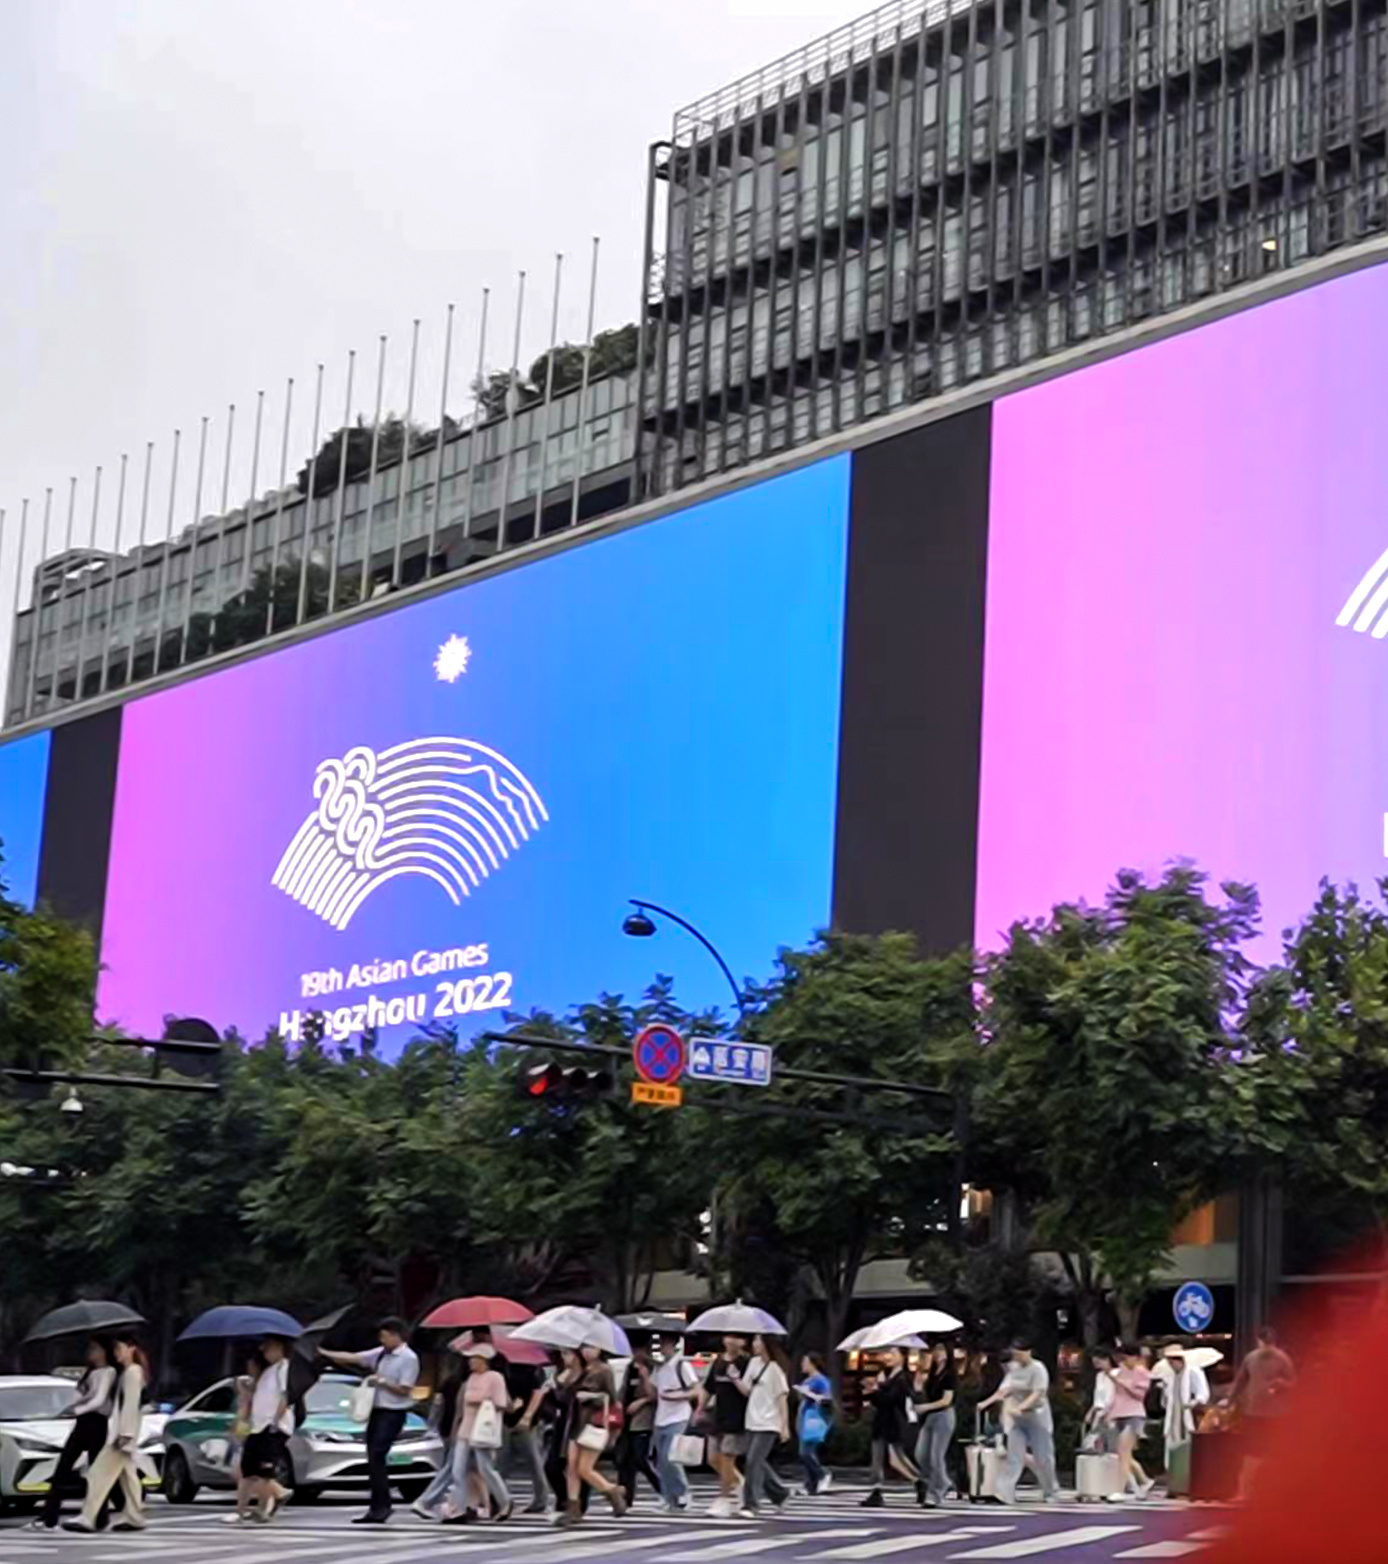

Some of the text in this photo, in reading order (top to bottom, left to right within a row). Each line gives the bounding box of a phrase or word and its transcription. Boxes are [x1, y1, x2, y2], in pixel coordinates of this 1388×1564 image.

[301, 943, 489, 997] 19th Asian Games
[278, 972, 512, 1041] Hgzhou 2022
